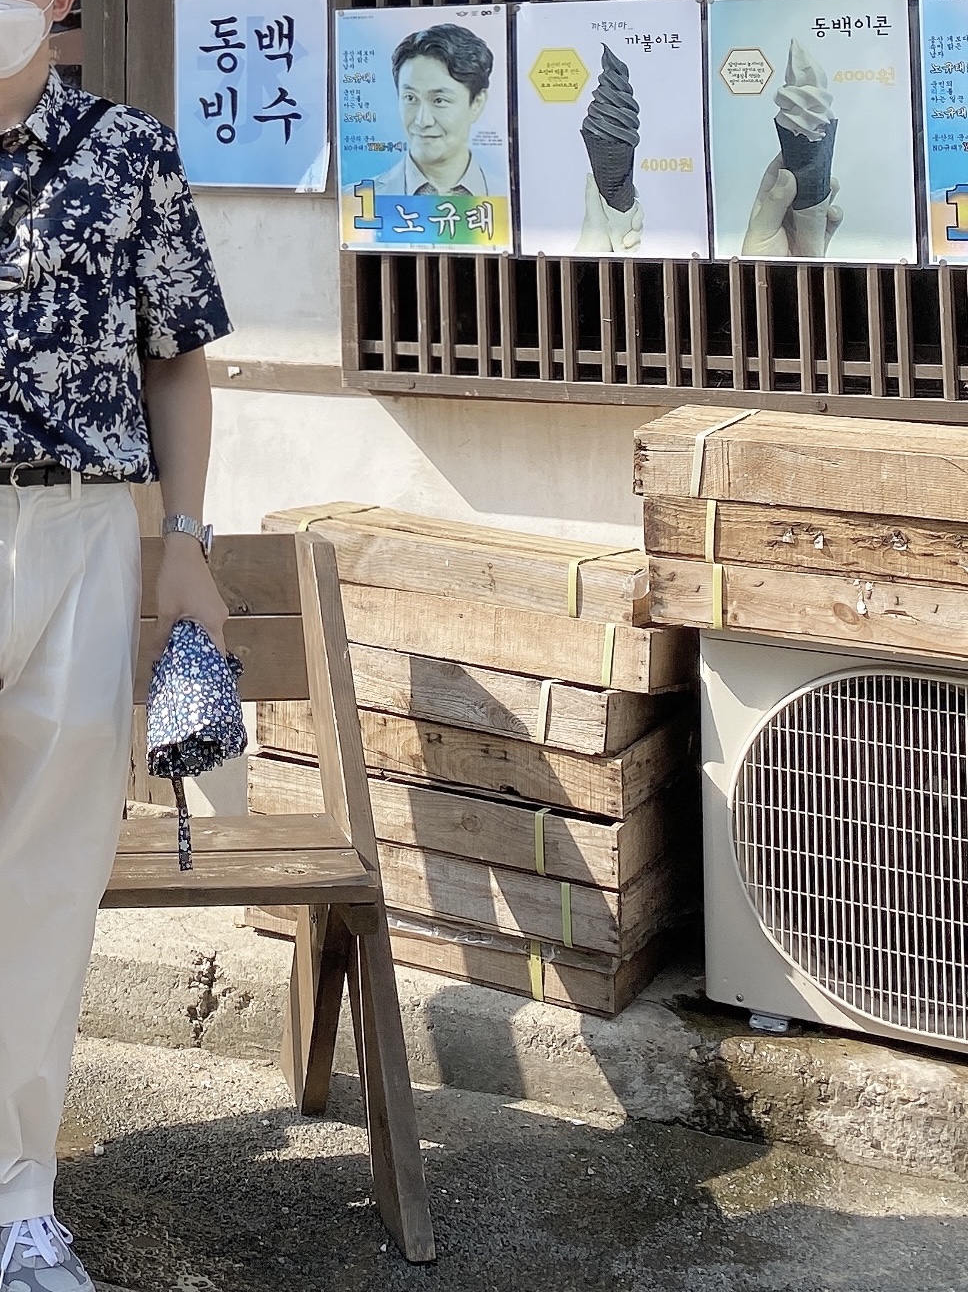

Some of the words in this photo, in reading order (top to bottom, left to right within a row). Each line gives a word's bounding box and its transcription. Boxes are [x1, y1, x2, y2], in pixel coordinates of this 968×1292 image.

[811, 15, 892, 39] 동백이콘
[198, 14, 295, 74] 동백
[624, 33, 683, 53] 까불이콘
[833, 66, 896, 87] 4000원
[198, 86, 303, 145] 빙수
[640, 157, 694, 173] 4000원
[353, 179, 384, 230] 1
[391, 200, 495, 241] 노규태
